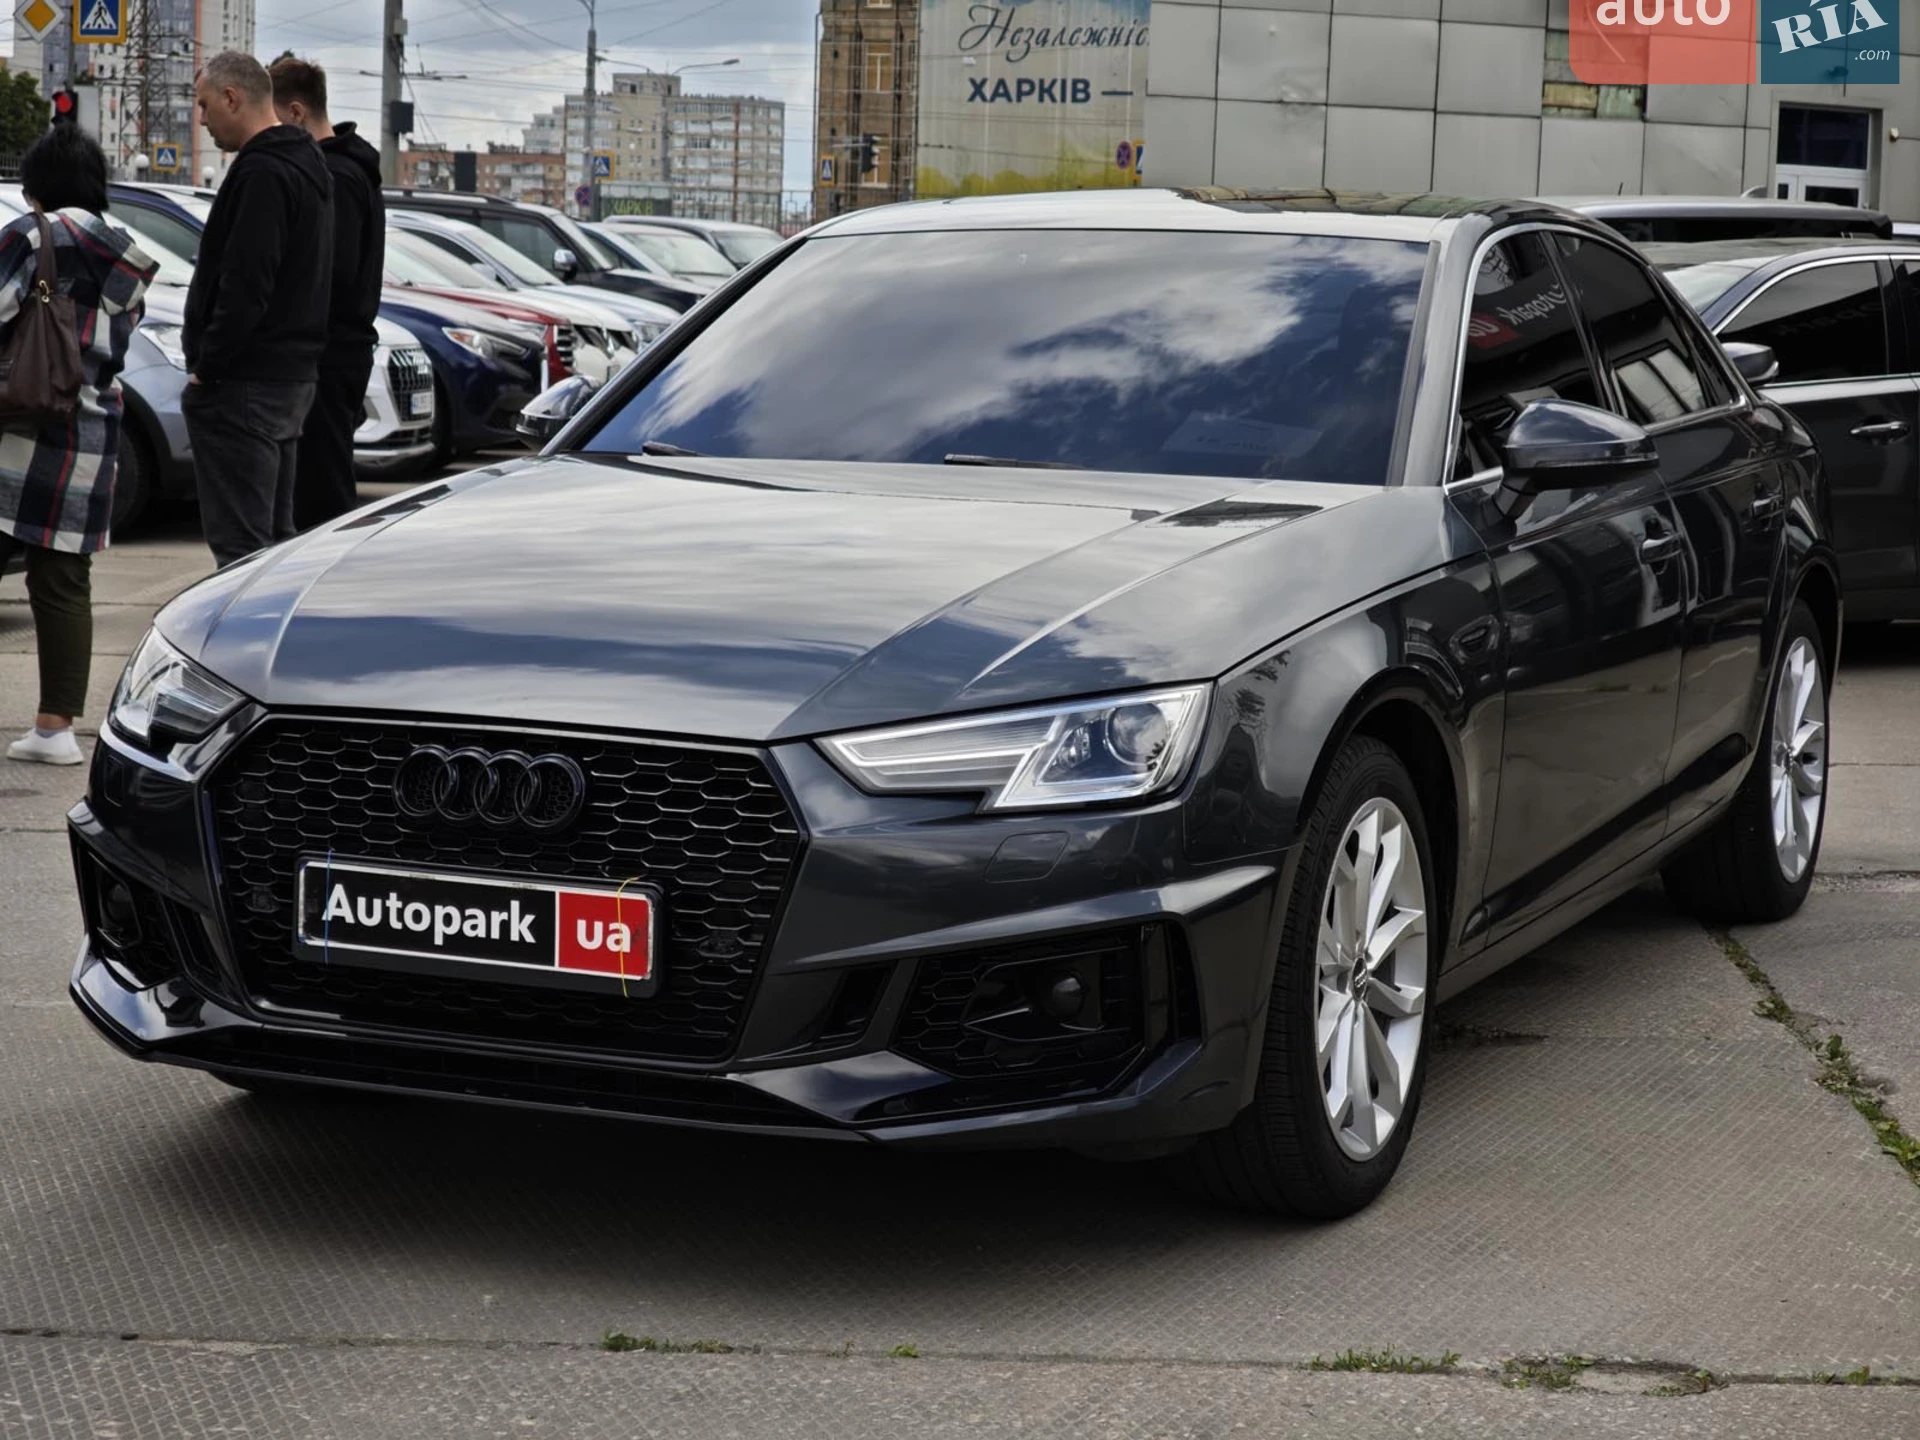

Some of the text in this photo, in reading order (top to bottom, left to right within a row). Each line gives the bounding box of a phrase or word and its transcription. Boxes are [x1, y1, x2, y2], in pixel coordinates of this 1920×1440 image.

[958, 4, 1150, 63] Незалежніс
[967, 77, 1092, 103] ХАРКІВ
[322, 883, 631, 953] Autopark ua
